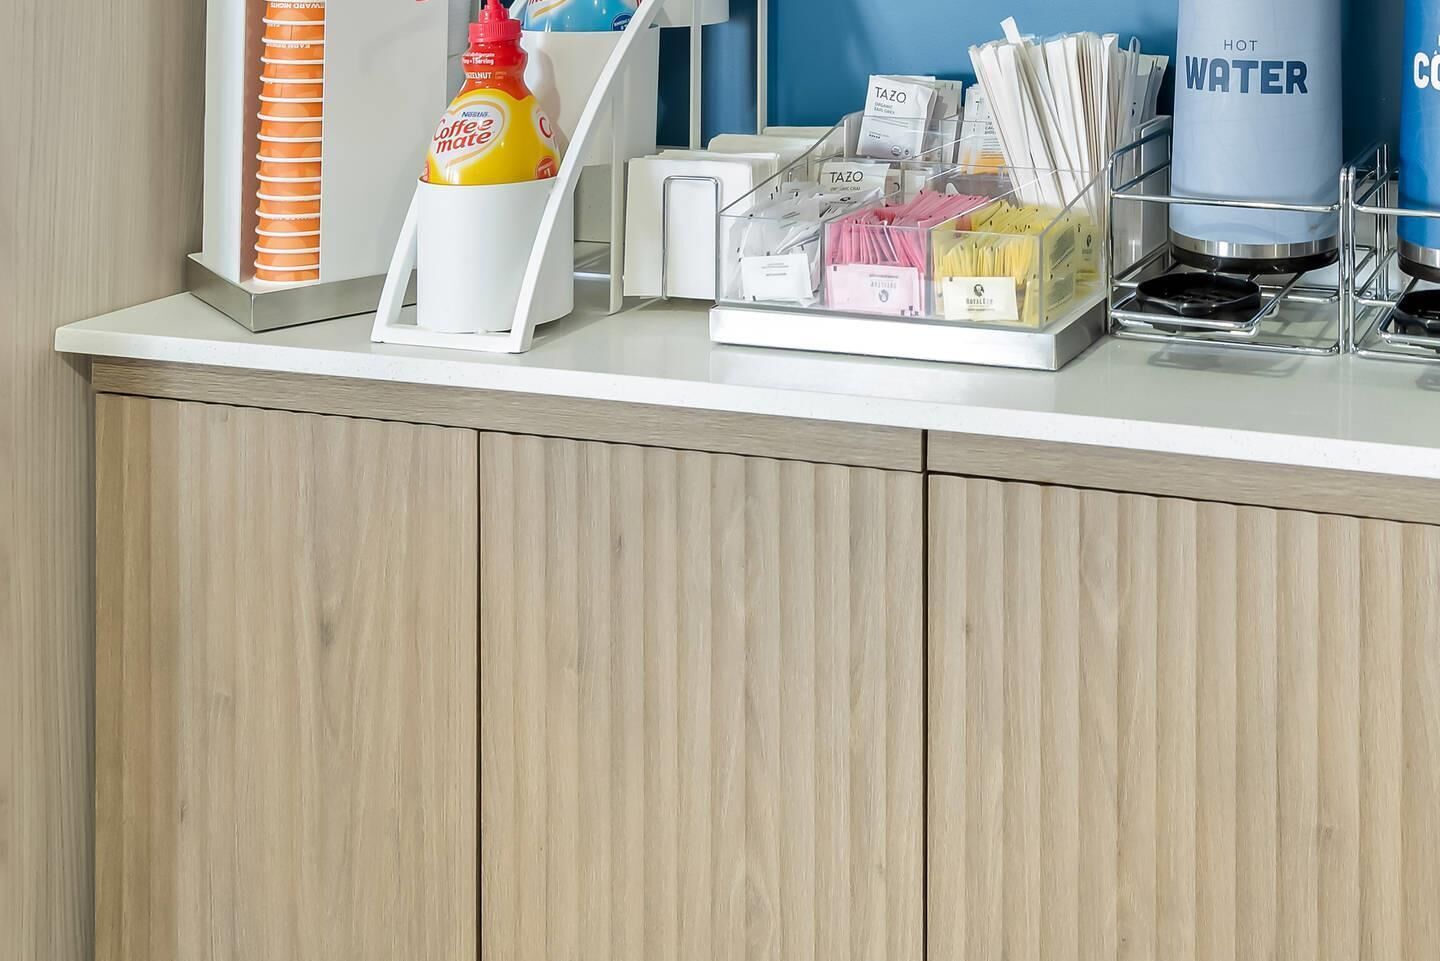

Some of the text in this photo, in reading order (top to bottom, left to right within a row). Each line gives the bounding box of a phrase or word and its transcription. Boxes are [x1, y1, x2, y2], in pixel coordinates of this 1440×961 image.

[1223, 39, 1258, 52] HOT
[1185, 55, 1308, 94] WATER
[875, 86, 907, 104] TAZO
[433, 118, 495, 141] Coffee
[436, 132, 492, 154] mate
[830, 171, 864, 183] TAZO
